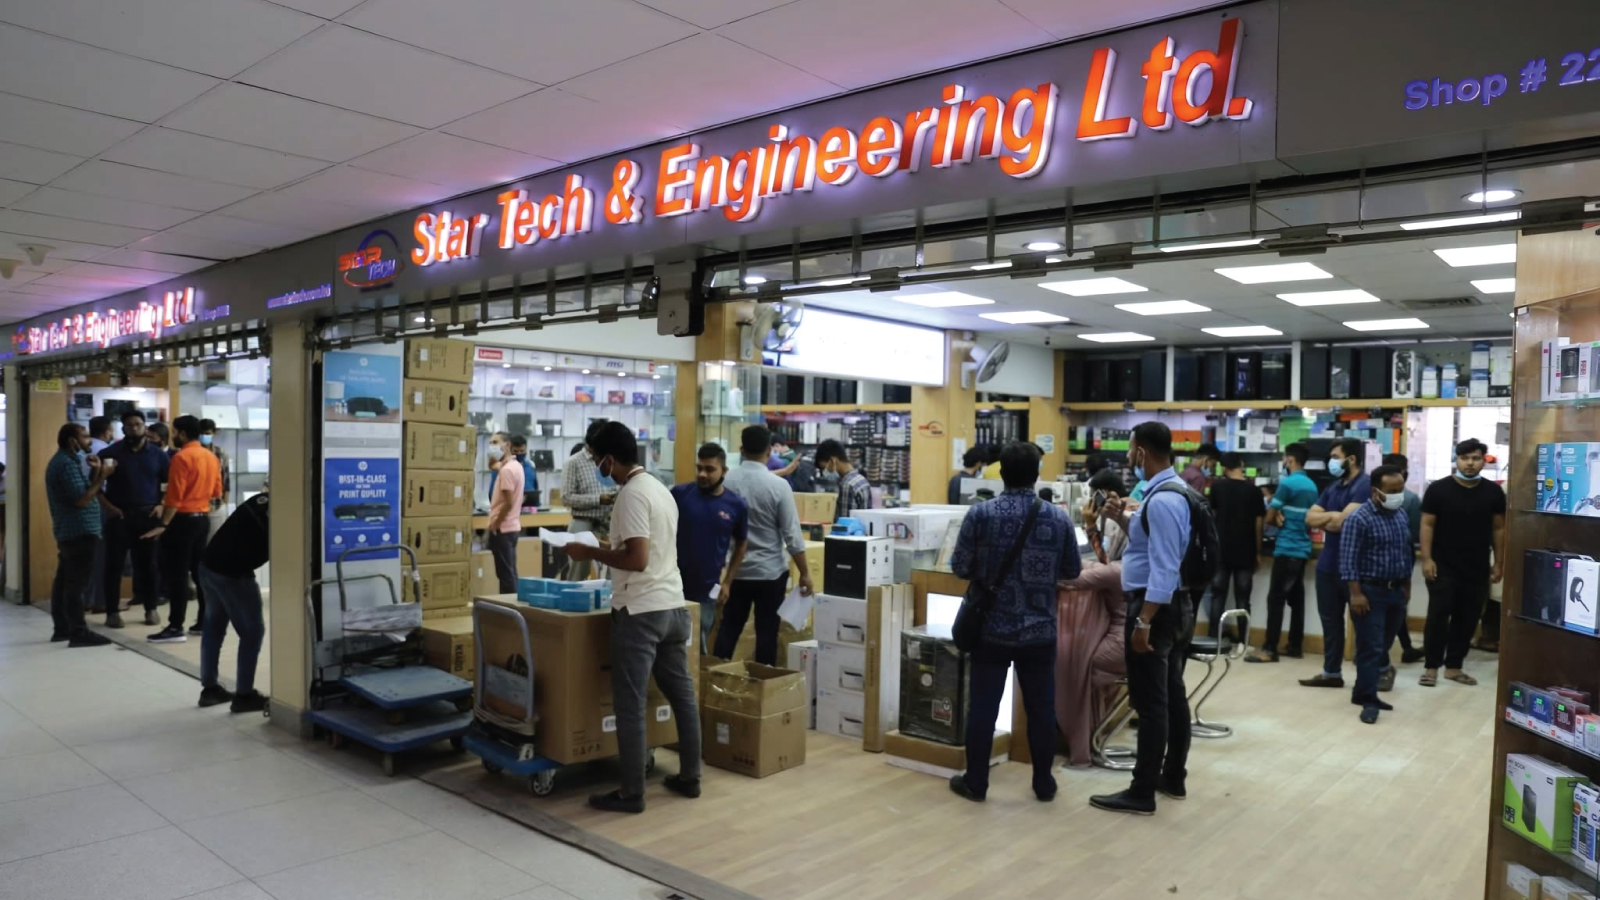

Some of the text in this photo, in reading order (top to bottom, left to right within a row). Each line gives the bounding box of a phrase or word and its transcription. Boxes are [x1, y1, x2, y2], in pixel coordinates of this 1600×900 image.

[1404, 73, 1508, 110] Shop
[1520, 57, 1547, 93] #
[411, 17, 1254, 267] Star Tech & Engineering Ltd.
[338, 489, 360, 499] PRINT
